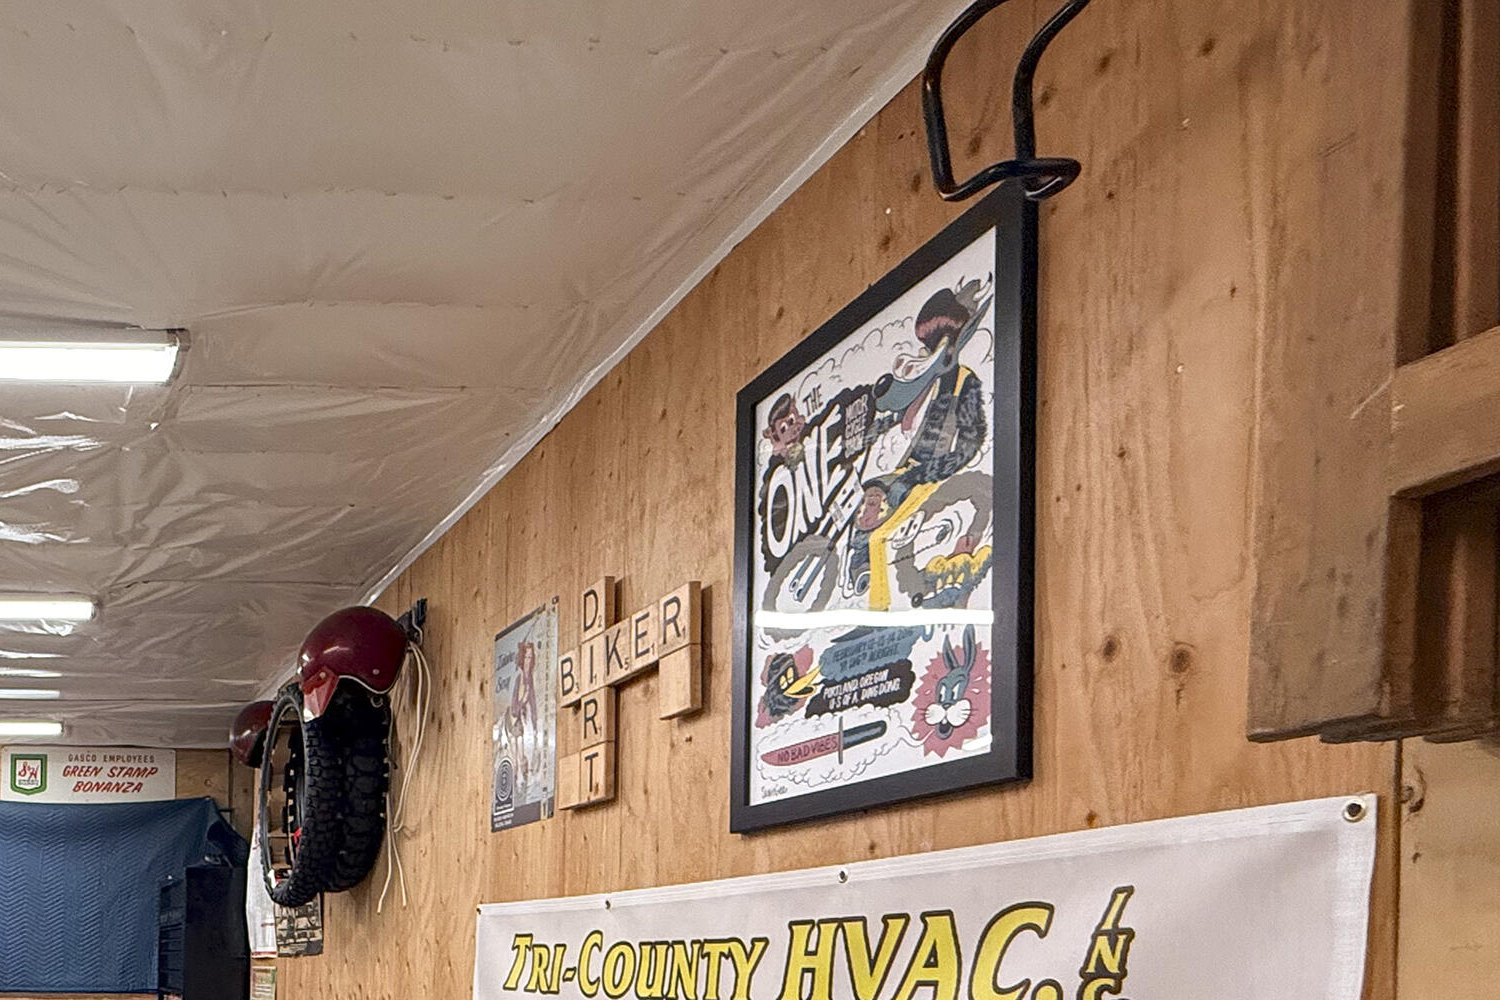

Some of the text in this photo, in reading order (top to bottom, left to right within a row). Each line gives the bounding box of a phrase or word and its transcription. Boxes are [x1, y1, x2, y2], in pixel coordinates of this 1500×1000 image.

[802, 384, 824, 417] THE
[766, 403, 847, 558] ONE
[68, 754, 156, 764] GASCO EMPLOYEES
[777, 735, 838, 764] NO BAD VIBES
[62, 765, 160, 778] GREEN STAMP
[72, 781, 144, 793] BONANZA
